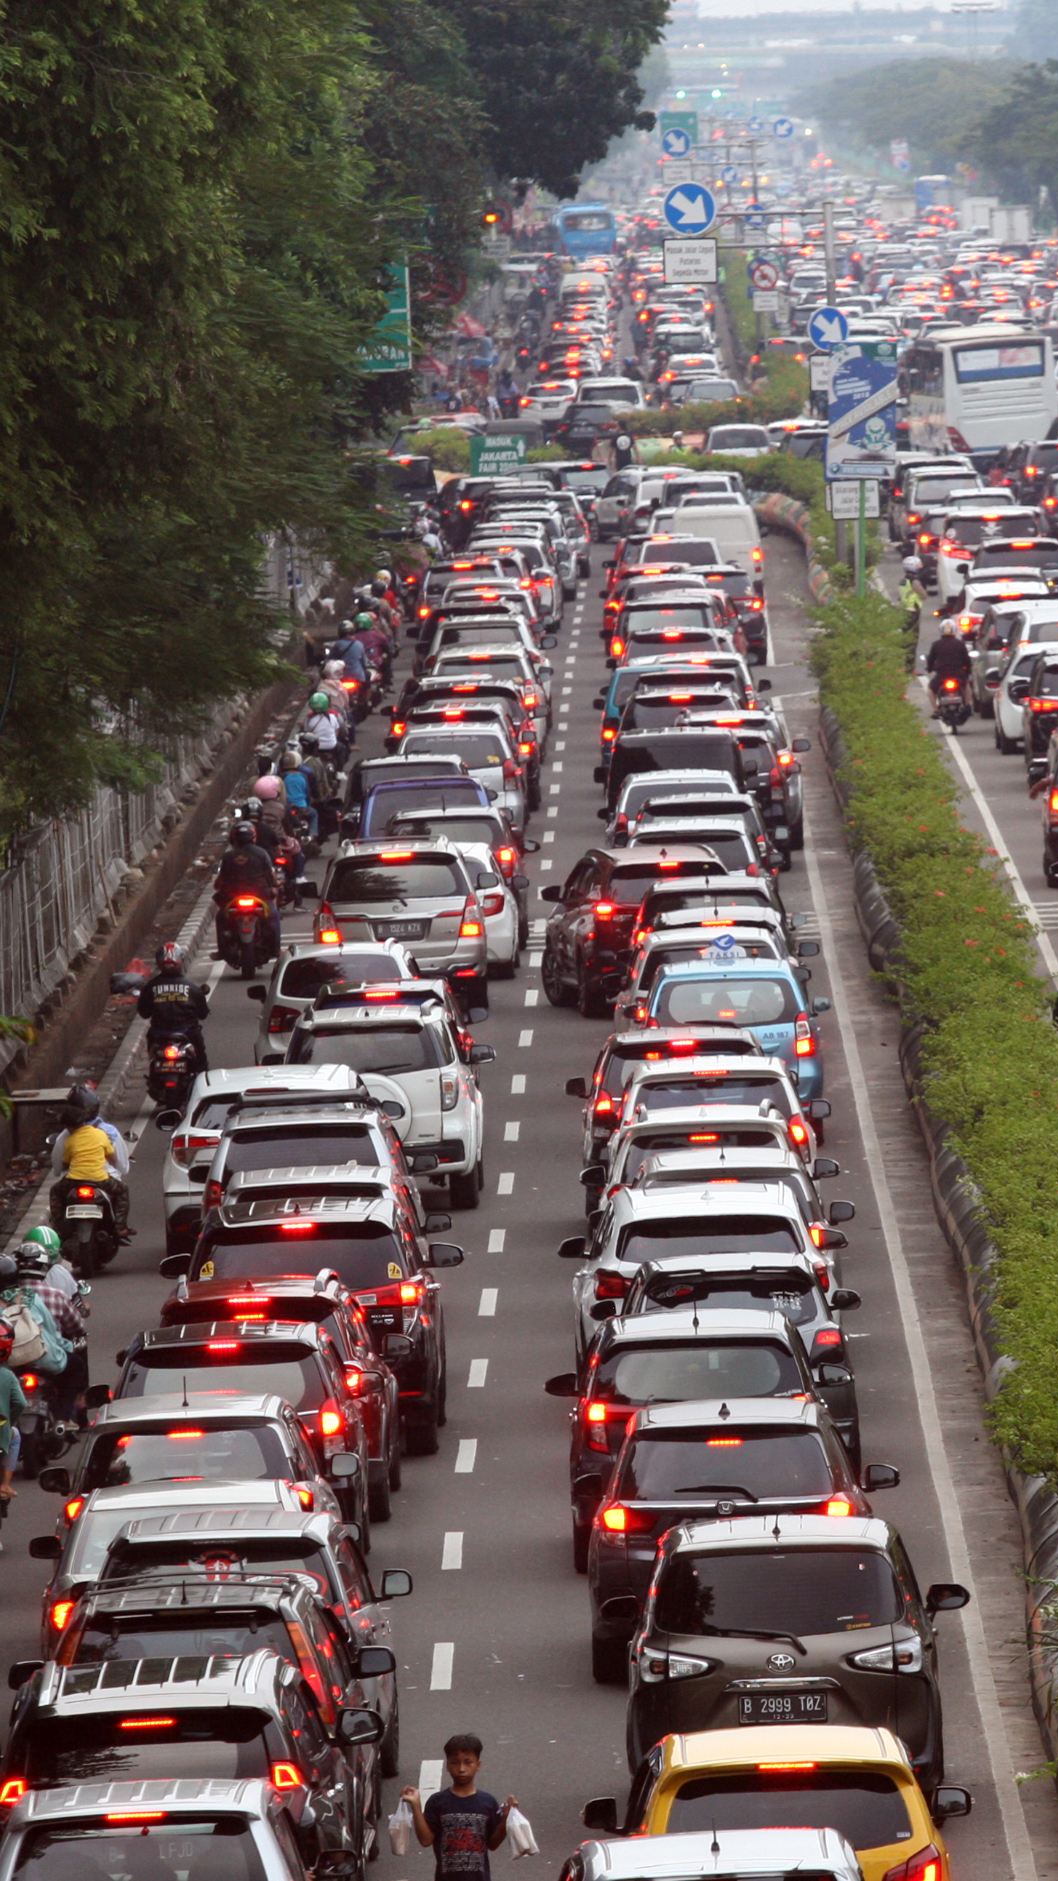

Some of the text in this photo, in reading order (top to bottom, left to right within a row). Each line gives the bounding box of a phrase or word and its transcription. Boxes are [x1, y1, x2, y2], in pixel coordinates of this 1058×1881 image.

[479, 451, 518, 461] JAKARTA
[479, 462, 497, 473] FAIR
[152, 984, 190, 997] SUNRISE
[744, 1699, 752, 1714] B
[760, 1698, 791, 1713] 2999
